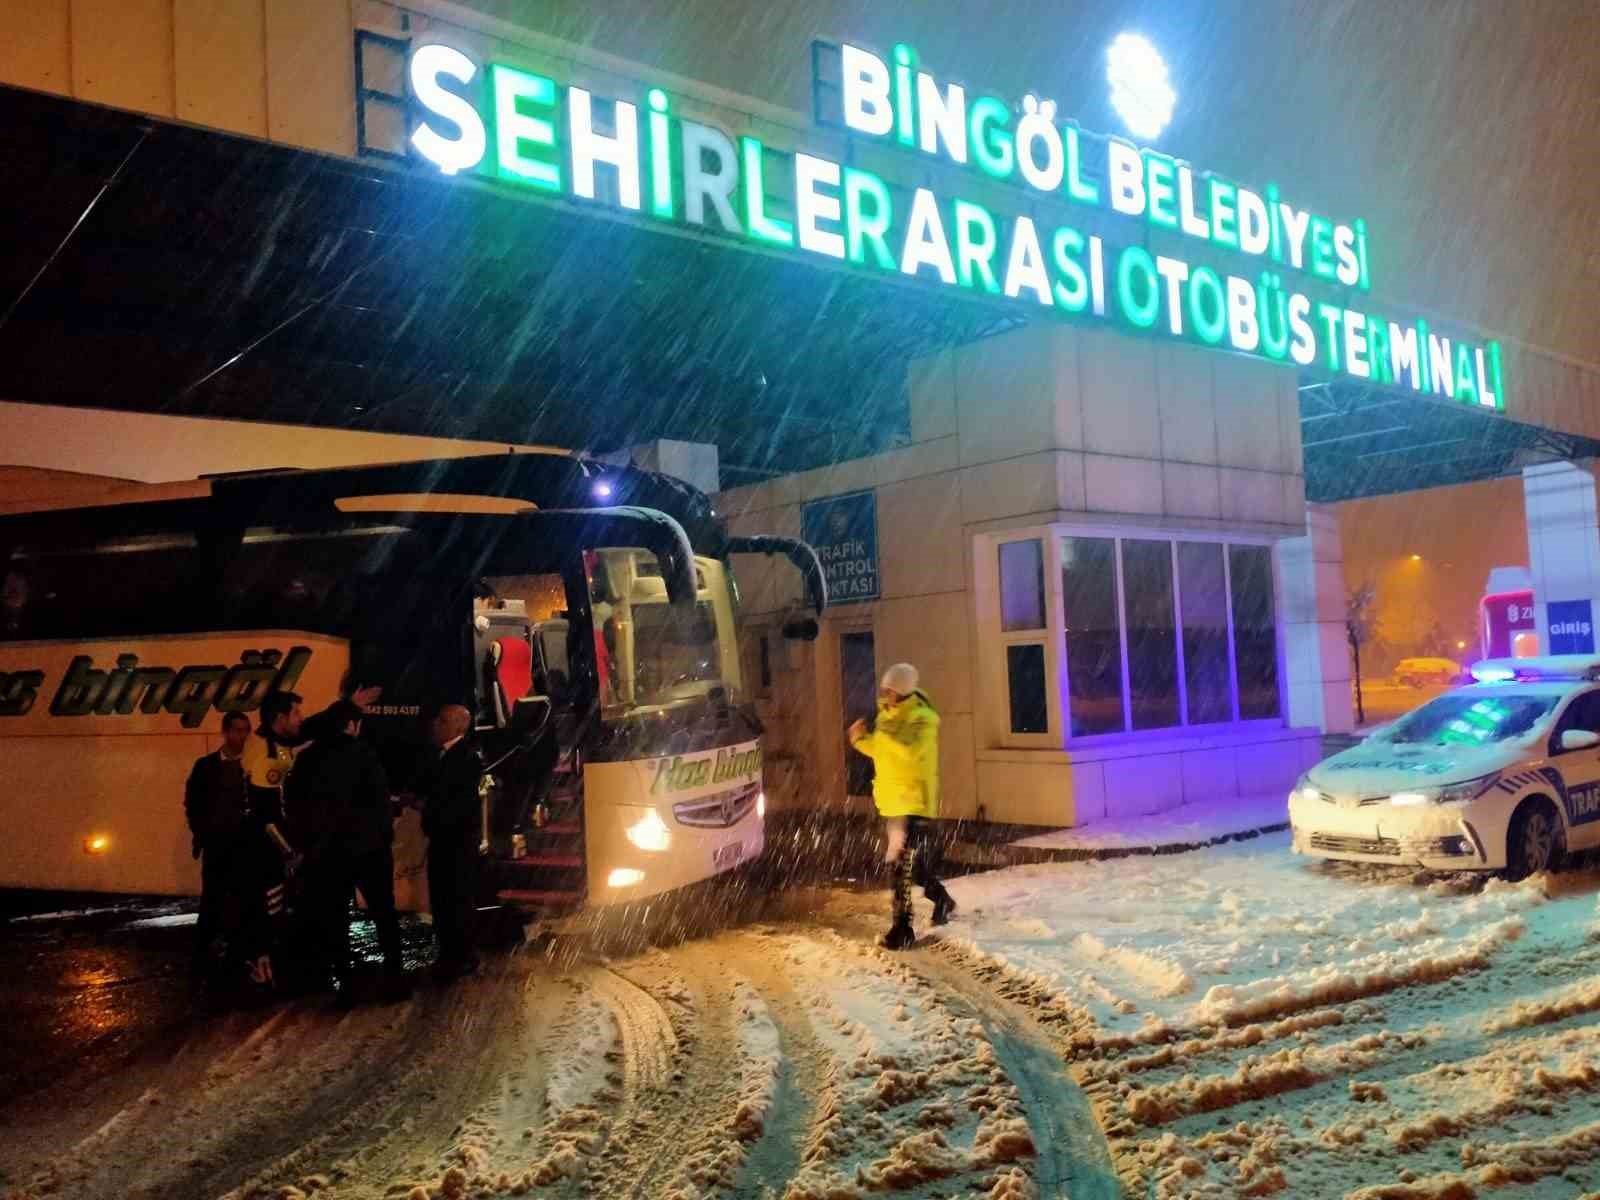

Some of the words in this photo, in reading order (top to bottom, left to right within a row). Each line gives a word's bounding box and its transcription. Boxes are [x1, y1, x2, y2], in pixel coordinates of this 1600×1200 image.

[410, 44, 1104, 317] ŞEHİRLERARASI
[1117, 246, 1316, 365] OTOBÜS
[1319, 303, 1504, 409] TERMİNALİ
[841, 43, 1098, 204] BİNGÖL
[1109, 138, 1368, 291] BELEDİYESİ
[823, 558, 874, 579] NTROL
